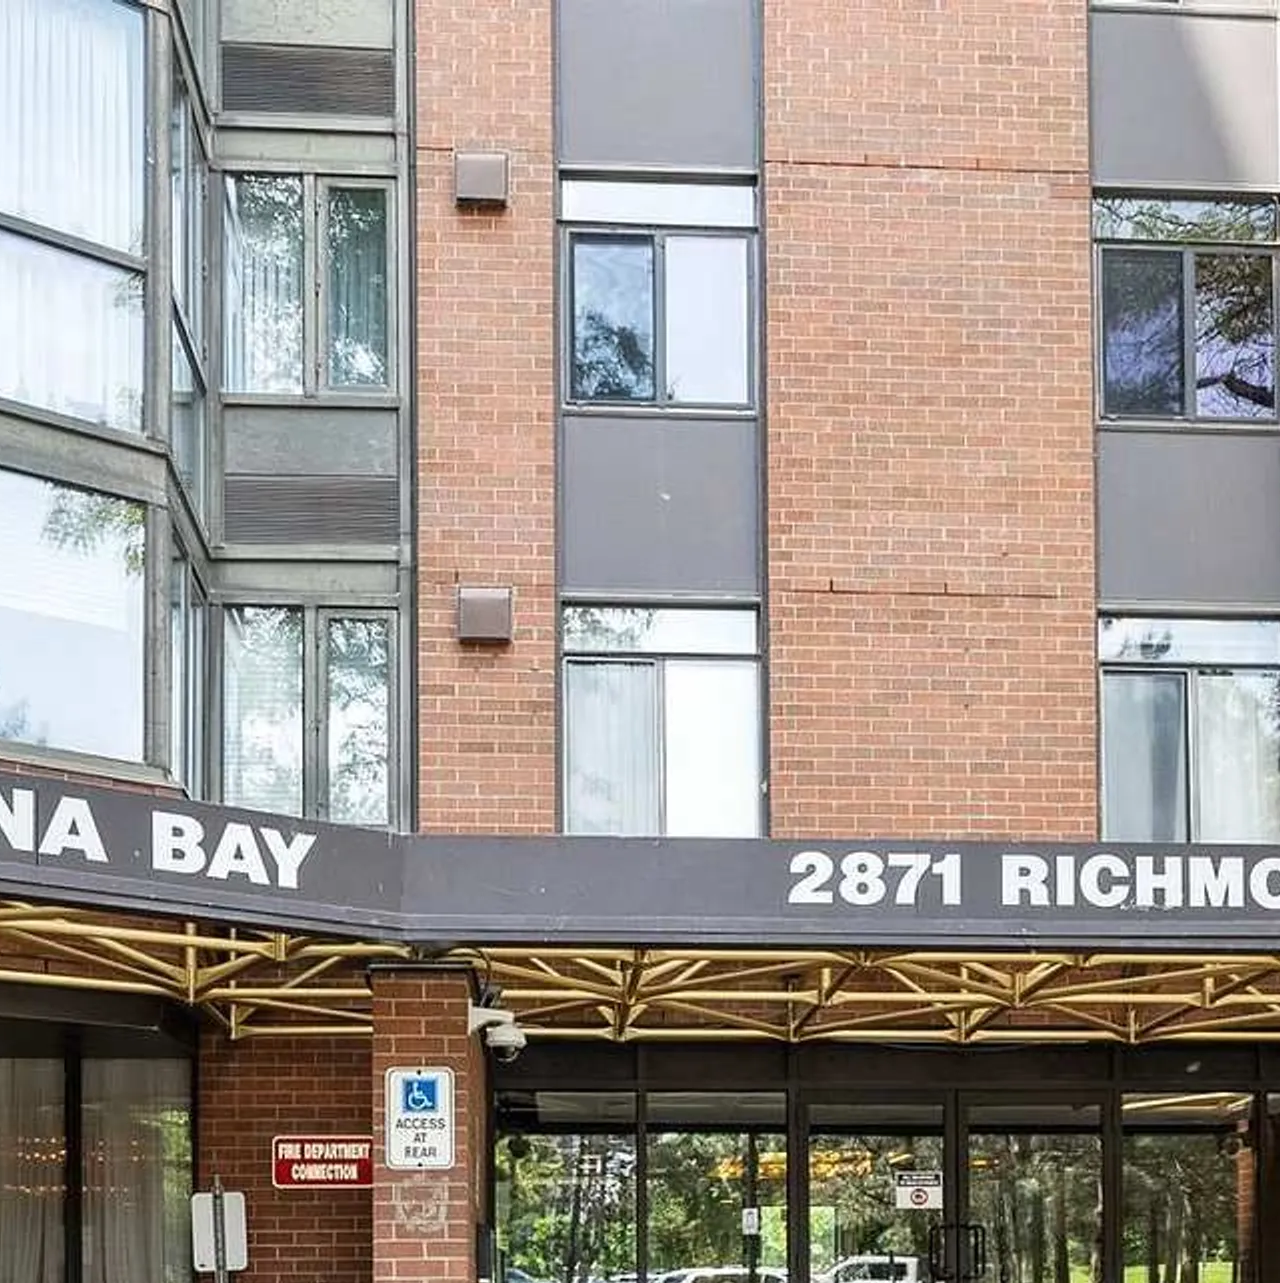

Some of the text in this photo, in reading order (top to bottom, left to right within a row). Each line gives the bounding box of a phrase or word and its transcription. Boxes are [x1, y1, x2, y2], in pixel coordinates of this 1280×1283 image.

[150, 809, 318, 889] BAY
[788, 851, 962, 905] 2871
[396, 1118, 446, 1129] ACCESS
[414, 1133, 427, 1143] AT
[278, 1143, 370, 1159] FIRE DEPARTMENT
[404, 1146, 437, 1158] REAR
[291, 1164, 359, 1181] CONNECTION
